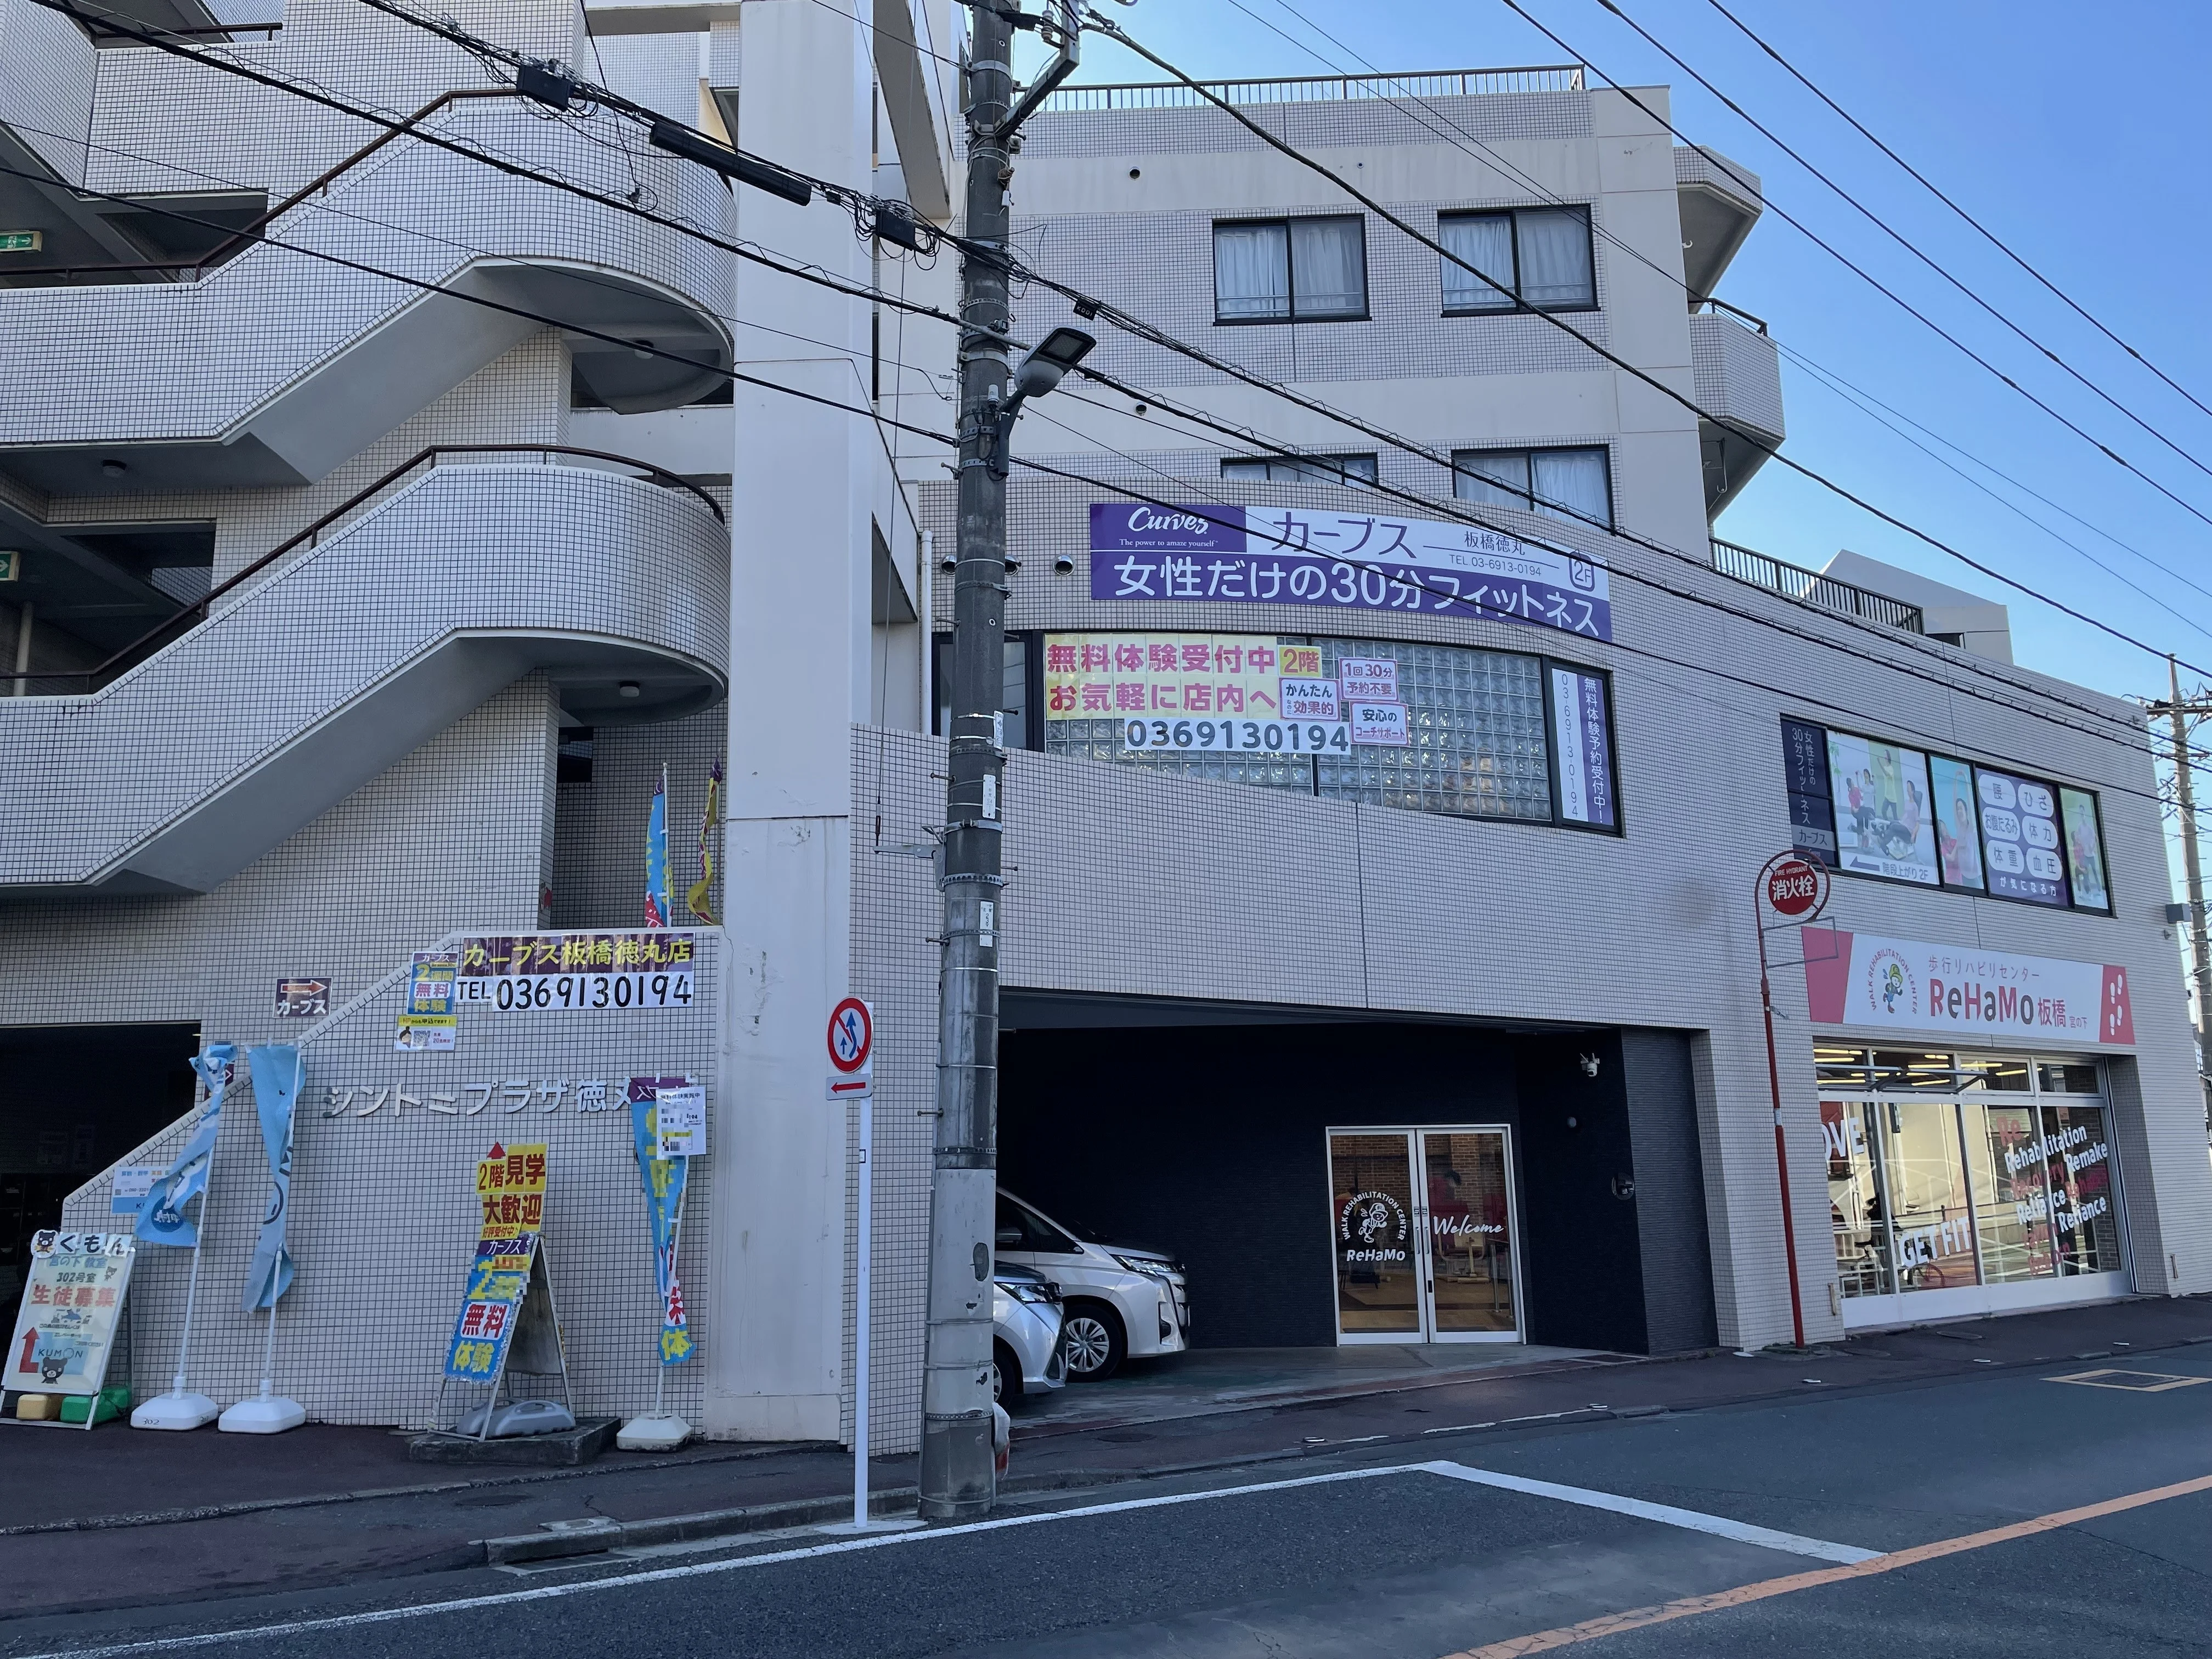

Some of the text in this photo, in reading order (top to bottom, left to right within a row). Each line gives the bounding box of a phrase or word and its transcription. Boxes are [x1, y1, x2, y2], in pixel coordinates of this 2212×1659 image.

[1128, 506, 1209, 534] Curves
[1188, 539, 1215, 548] yourself
[1272, 511, 1417, 558] カーブス
[1464, 531, 1525, 555] 板橋徳丸
[1449, 554, 1542, 577] TEL.03-6913-0194
[1574, 560, 1592, 583] 2F
[1114, 555, 1599, 636] 女性だけの30分フィットネス
[1047, 644, 1275, 674] 無料体験受付中
[1283, 648, 1319, 673] 2階
[1049, 682, 1277, 712] お気軽に店内へ
[1286, 684, 1332, 698] かんたん
[1347, 682, 1392, 695] 予約不要
[1293, 701, 1334, 715] 効果的
[1362, 709, 1397, 722] 安心の
[1127, 719, 1348, 751] 0369130194
[1356, 726, 1405, 740] コーチサポート
[1561, 674, 1578, 817] 03-6913-0194
[1799, 829, 1827, 845] カーブス
[2029, 823, 2052, 842] 体力
[1994, 847, 2018, 867] 体重
[2033, 855, 2056, 874] 血圧
[1786, 866, 1808, 874] HYDRANT
[1772, 874, 1814, 901] 消火栓
[464, 938, 692, 967] カーブス板橋徳丸店
[1928, 955, 2040, 981] 歩行リハビリセンター
[415, 983, 449, 997] 無料
[458, 974, 691, 1010] TEL 0369130194
[276, 998, 326, 1014] カーブス
[414, 999, 447, 1012] 体験
[1930, 978, 2034, 1025] ReHaMo
[2038, 997, 2066, 1028] 板橋
[2005, 1126, 2088, 1173] Rehablitation
[2065, 1141, 2108, 1173] Remake
[479, 1153, 545, 1190] 2階 見学
[483, 1194, 542, 1224] 大歓迎
[1341, 1191, 1407, 1240] WALK REHABILITATION CENTER
[1433, 1215, 1504, 1237] Welcome
[60, 1234, 125, 1255] くもん
[1899, 1216, 1970, 1268] GET FIT
[1346, 1249, 1406, 1261] ReHaMo
[57, 1272, 96, 1283] 302号室
[31, 1284, 116, 1307] 生徒募集
[462, 1303, 508, 1338] 無料
[38, 1348, 83, 1359] KUMON
[453, 1340, 495, 1373] 体験
